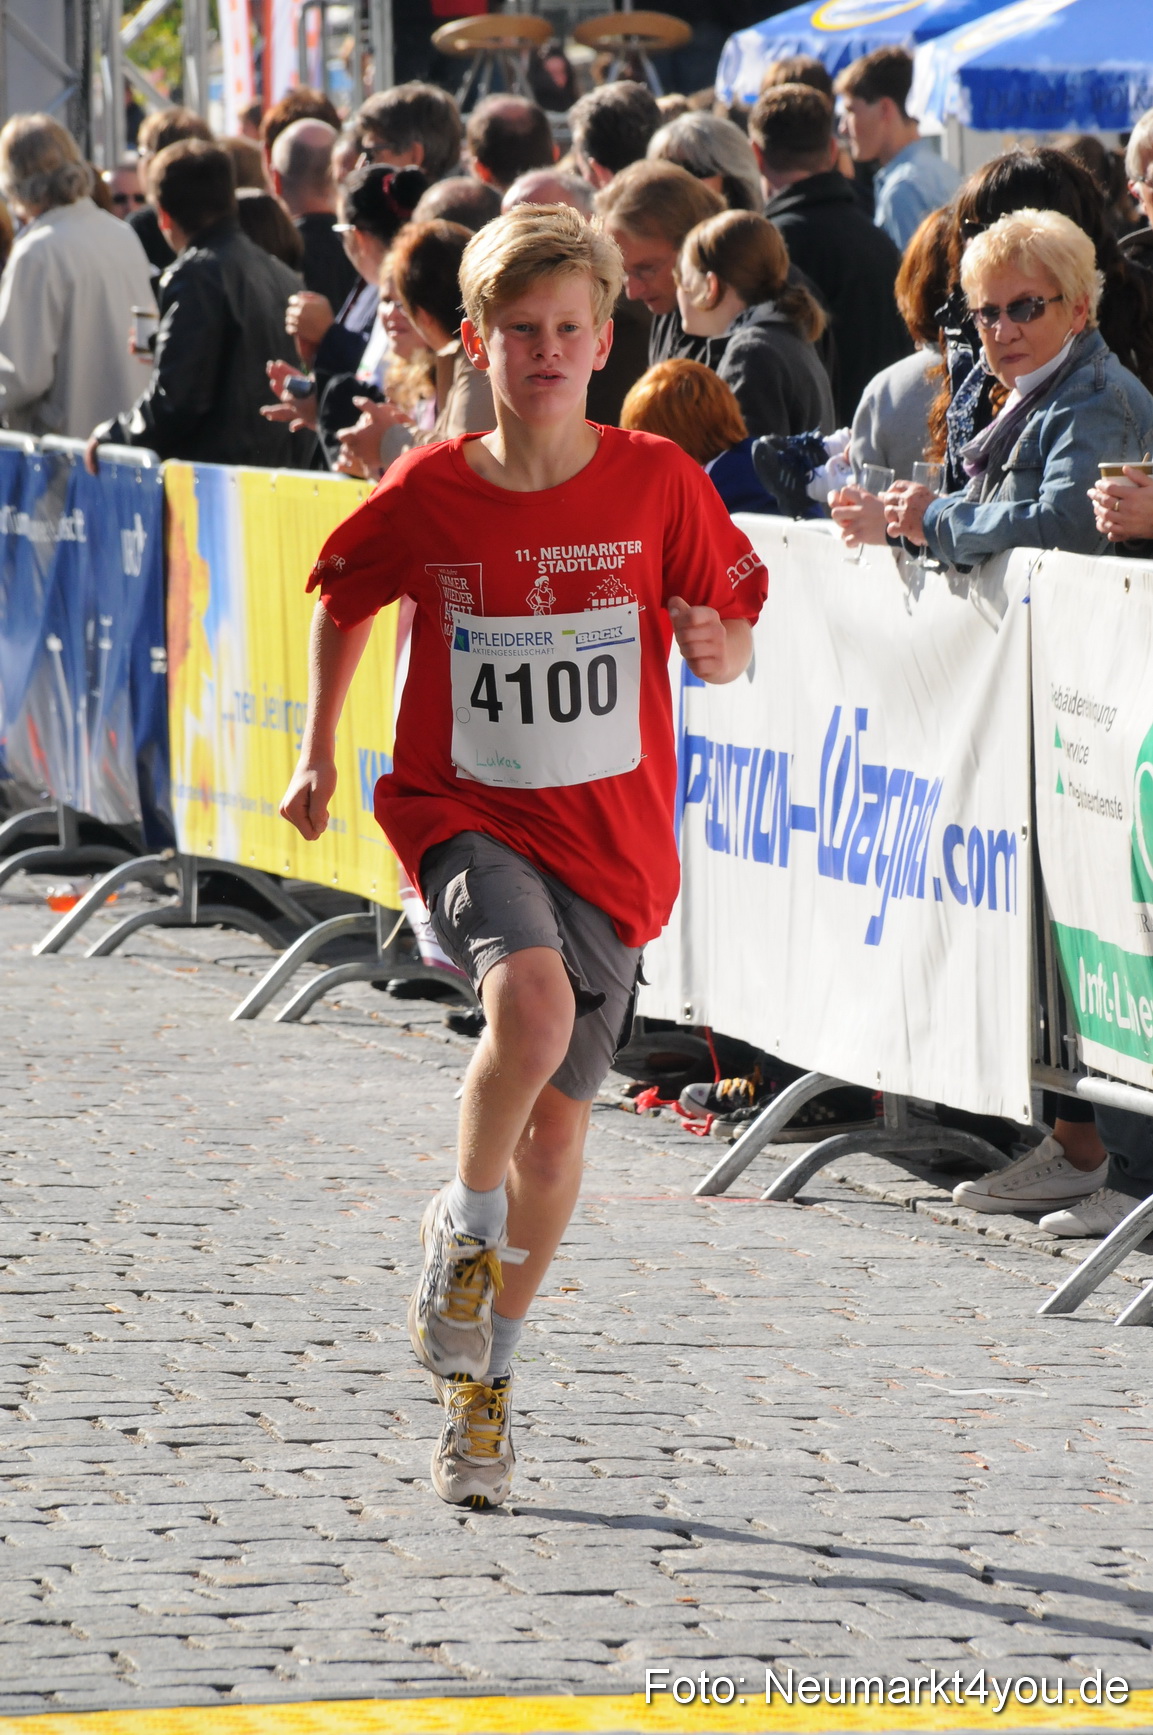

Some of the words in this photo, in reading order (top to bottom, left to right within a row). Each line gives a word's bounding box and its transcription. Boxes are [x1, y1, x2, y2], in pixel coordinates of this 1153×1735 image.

[515, 549, 537, 562] 11.
[540, 540, 643, 560] NEUMARKTER
[537, 555, 626, 574] STADTLAUF
[438, 573, 469, 590] IMMER
[443, 586, 475, 604] WIEDER
[471, 631, 554, 647] PFLEIDERER
[575, 625, 623, 644] BOCK
[472, 647, 555, 657] AKTIENGESELLSCHAFT
[470, 654, 618, 724] 4100
[476, 749, 522, 769] Lukas
